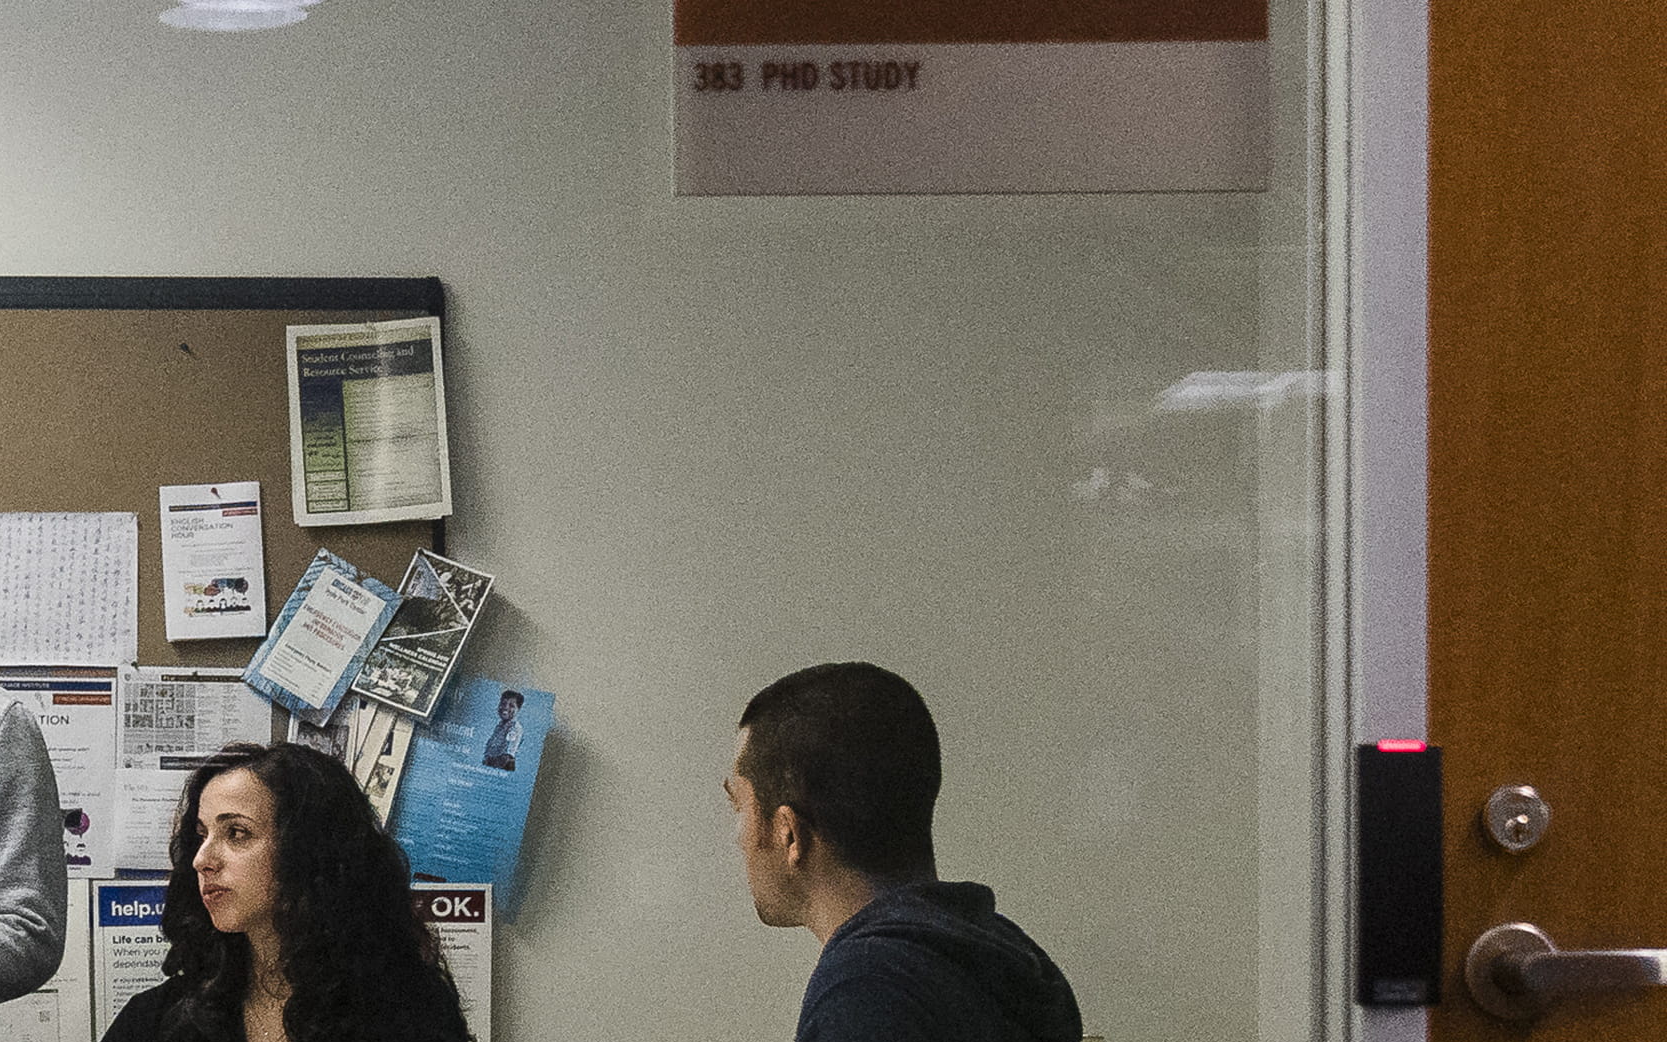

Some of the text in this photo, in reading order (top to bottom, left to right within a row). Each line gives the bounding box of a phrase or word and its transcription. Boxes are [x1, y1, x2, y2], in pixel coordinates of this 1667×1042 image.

[695, 61, 919, 91] 383 PHD STUDY
[39, 714, 70, 726] TION
[111, 900, 166, 919] help.u
[431, 896, 480, 918] OK.
[112, 936, 132, 945] Life
[134, 935, 154, 944] can
[113, 948, 141, 957] When
[142, 949, 161, 958] you
